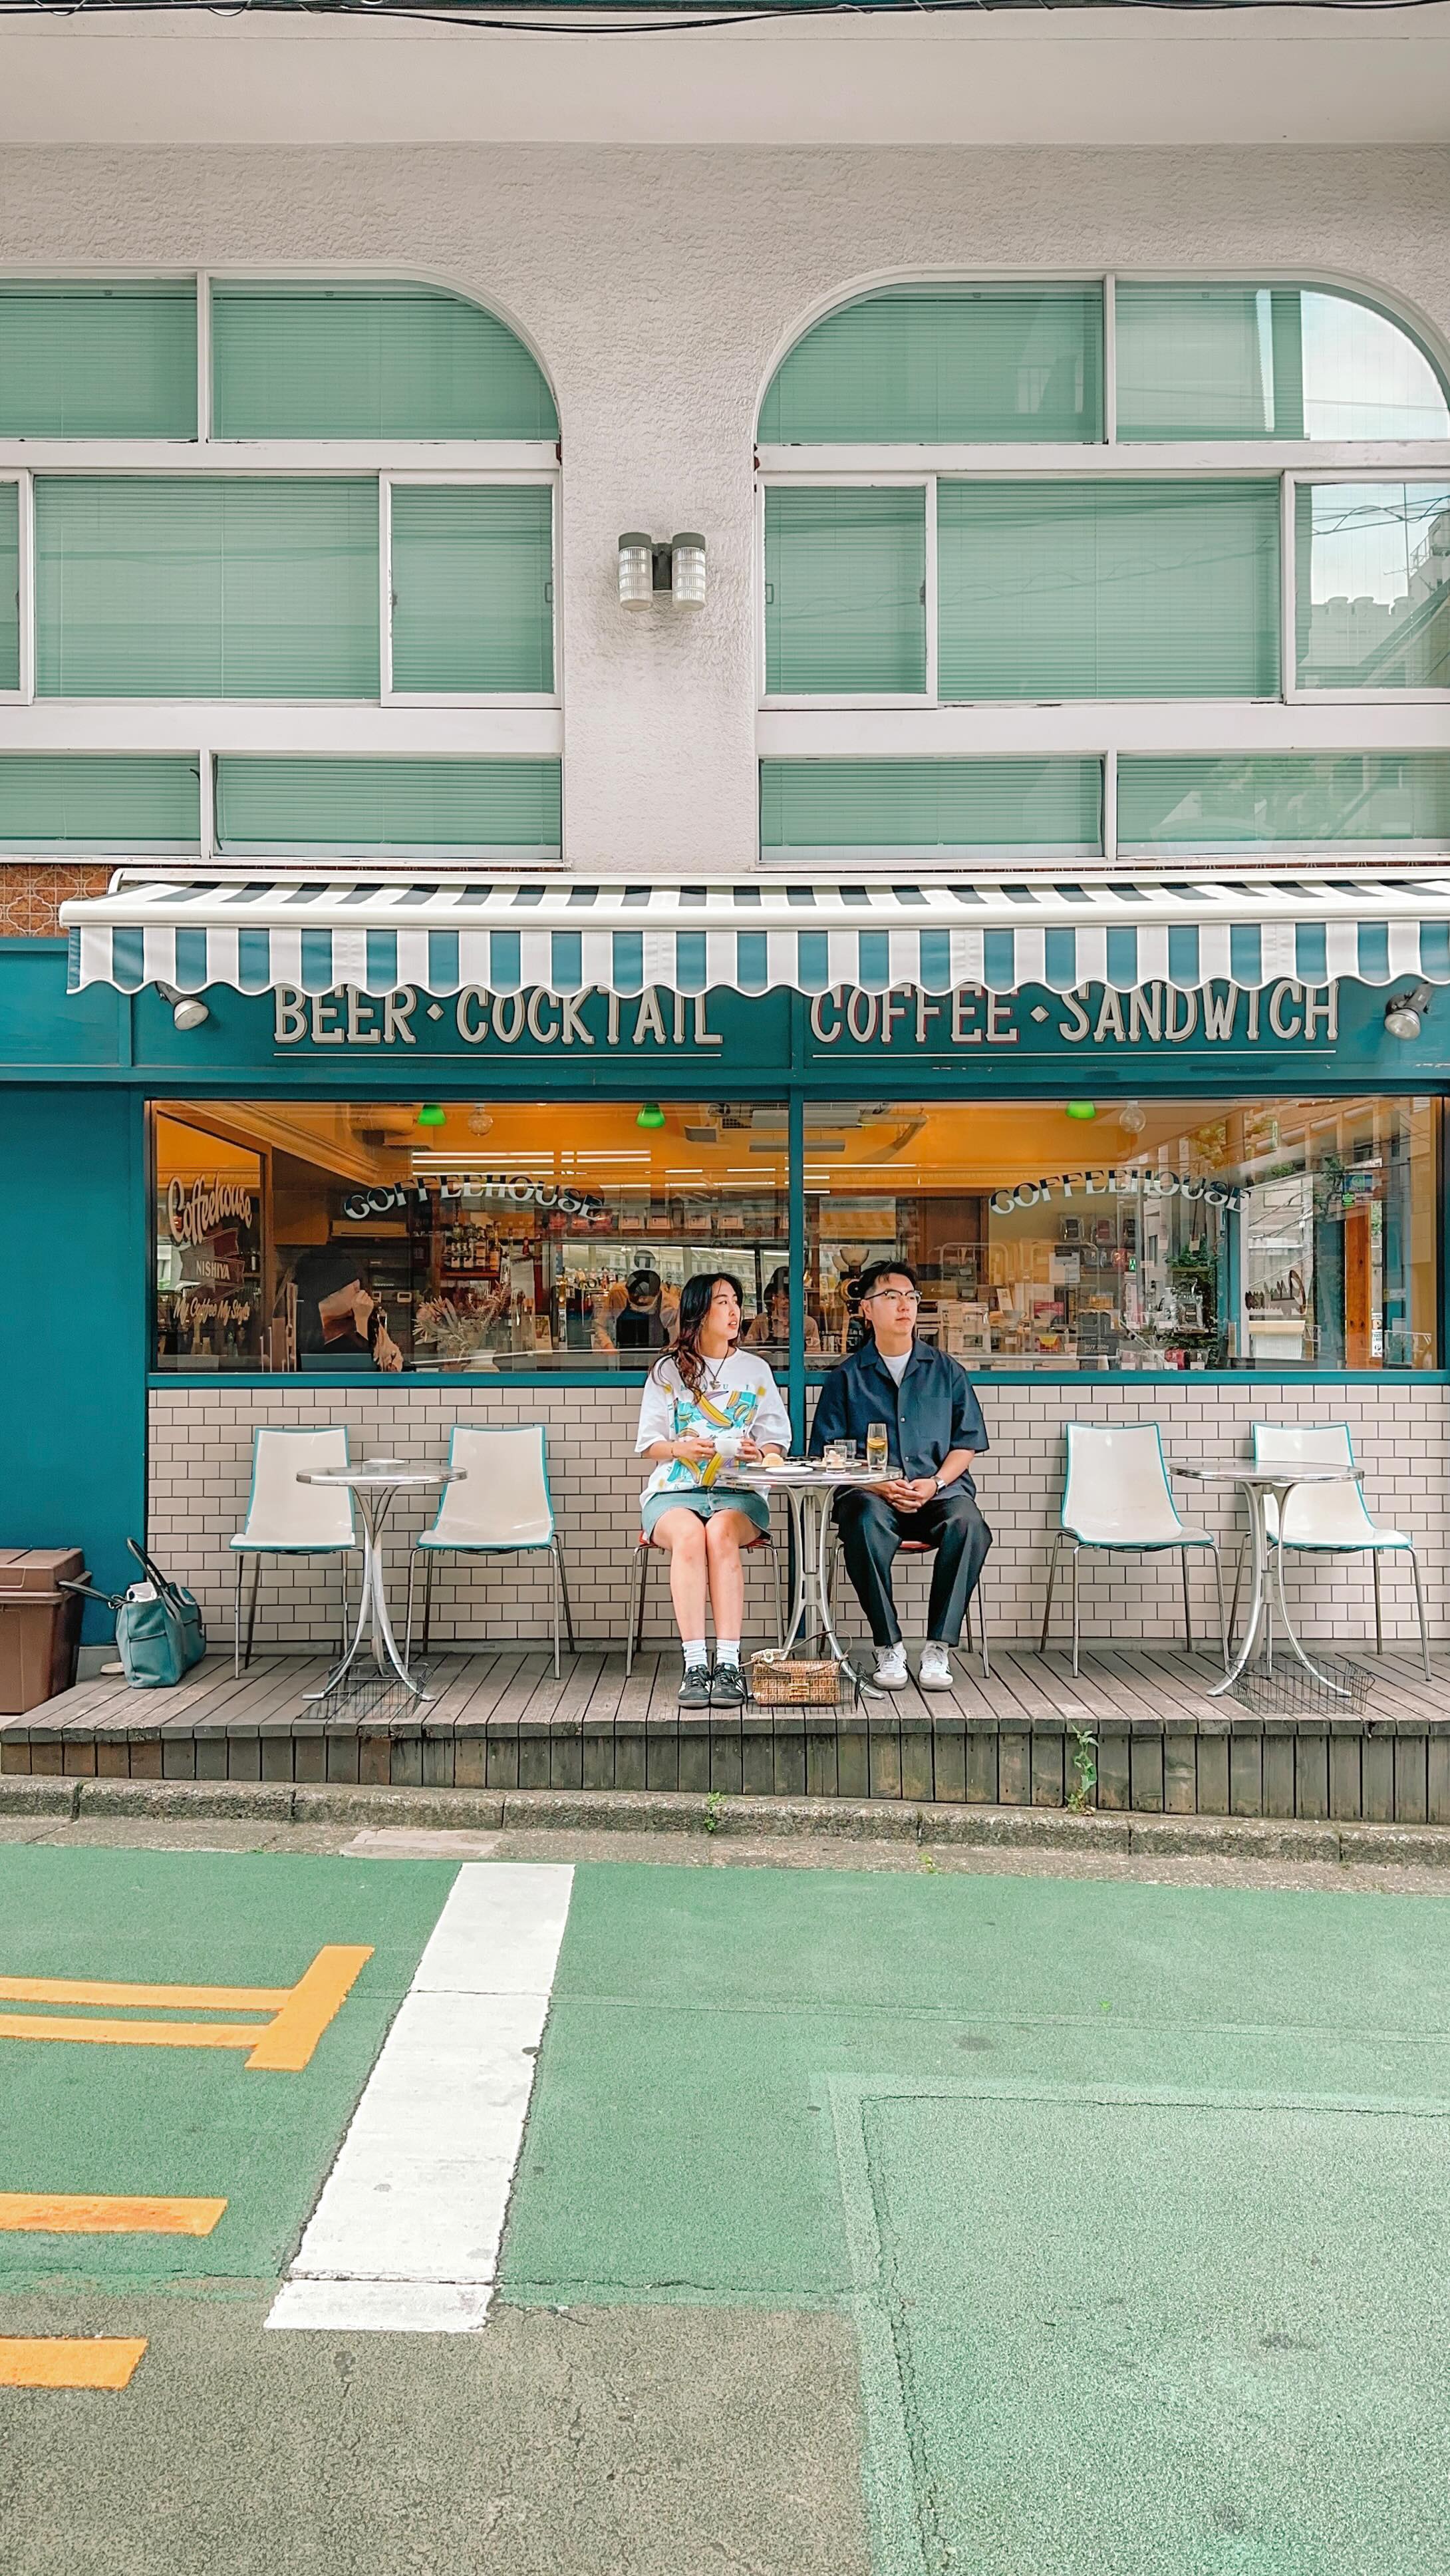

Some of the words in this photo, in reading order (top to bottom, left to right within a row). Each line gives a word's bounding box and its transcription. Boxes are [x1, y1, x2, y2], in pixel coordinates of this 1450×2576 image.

[273, 983, 416, 1044] BEER
[456, 984, 723, 1045] COCKTAIL
[809, 983, 1019, 1044] COFFEE
[1058, 980, 1340, 1043] SANDWICH
[168, 1170, 253, 1245] Coffeehouse
[343, 1174, 605, 1221] COFFEEHOUSE
[988, 1169, 1252, 1215] COFFEEHOUSE
[196, 1260, 230, 1280] NISHIYA
[173, 1297, 189, 1325] My
[218, 1300, 231, 1326] My
